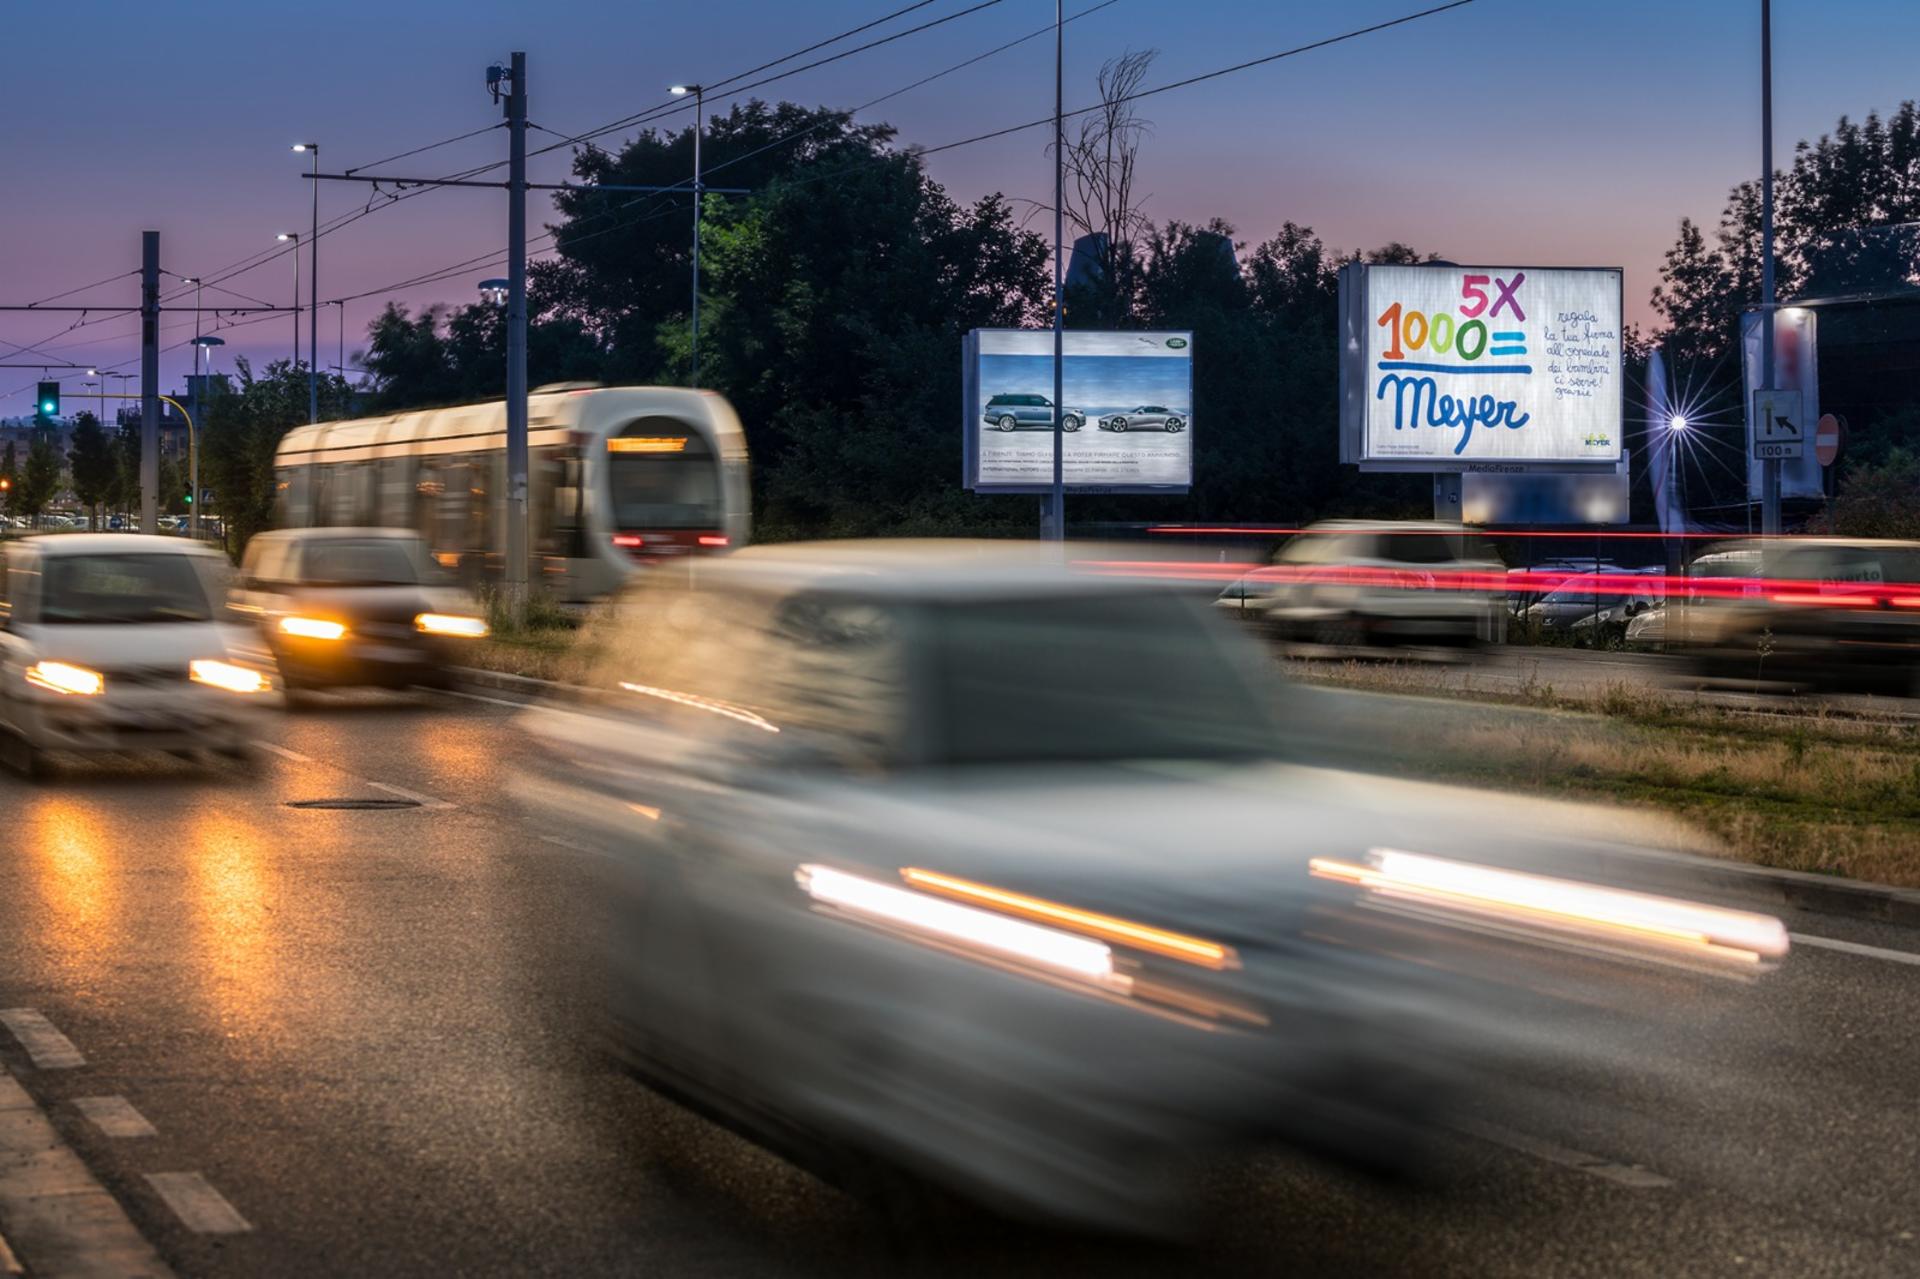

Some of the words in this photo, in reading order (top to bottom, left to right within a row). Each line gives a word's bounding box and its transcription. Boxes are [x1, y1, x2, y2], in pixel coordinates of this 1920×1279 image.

[1459, 272, 1526, 322] 5X
[1558, 310, 1598, 328] regala
[1544, 326, 1558, 341] la
[1561, 327, 1580, 342] tua
[1547, 360, 1562, 373] dei
[1566, 358, 1610, 374] bambini
[1554, 375, 1565, 385] ci
[1555, 387, 1592, 401] grazie
[1377, 373, 1530, 455] Meyer
[1761, 446, 1782, 456] 100
